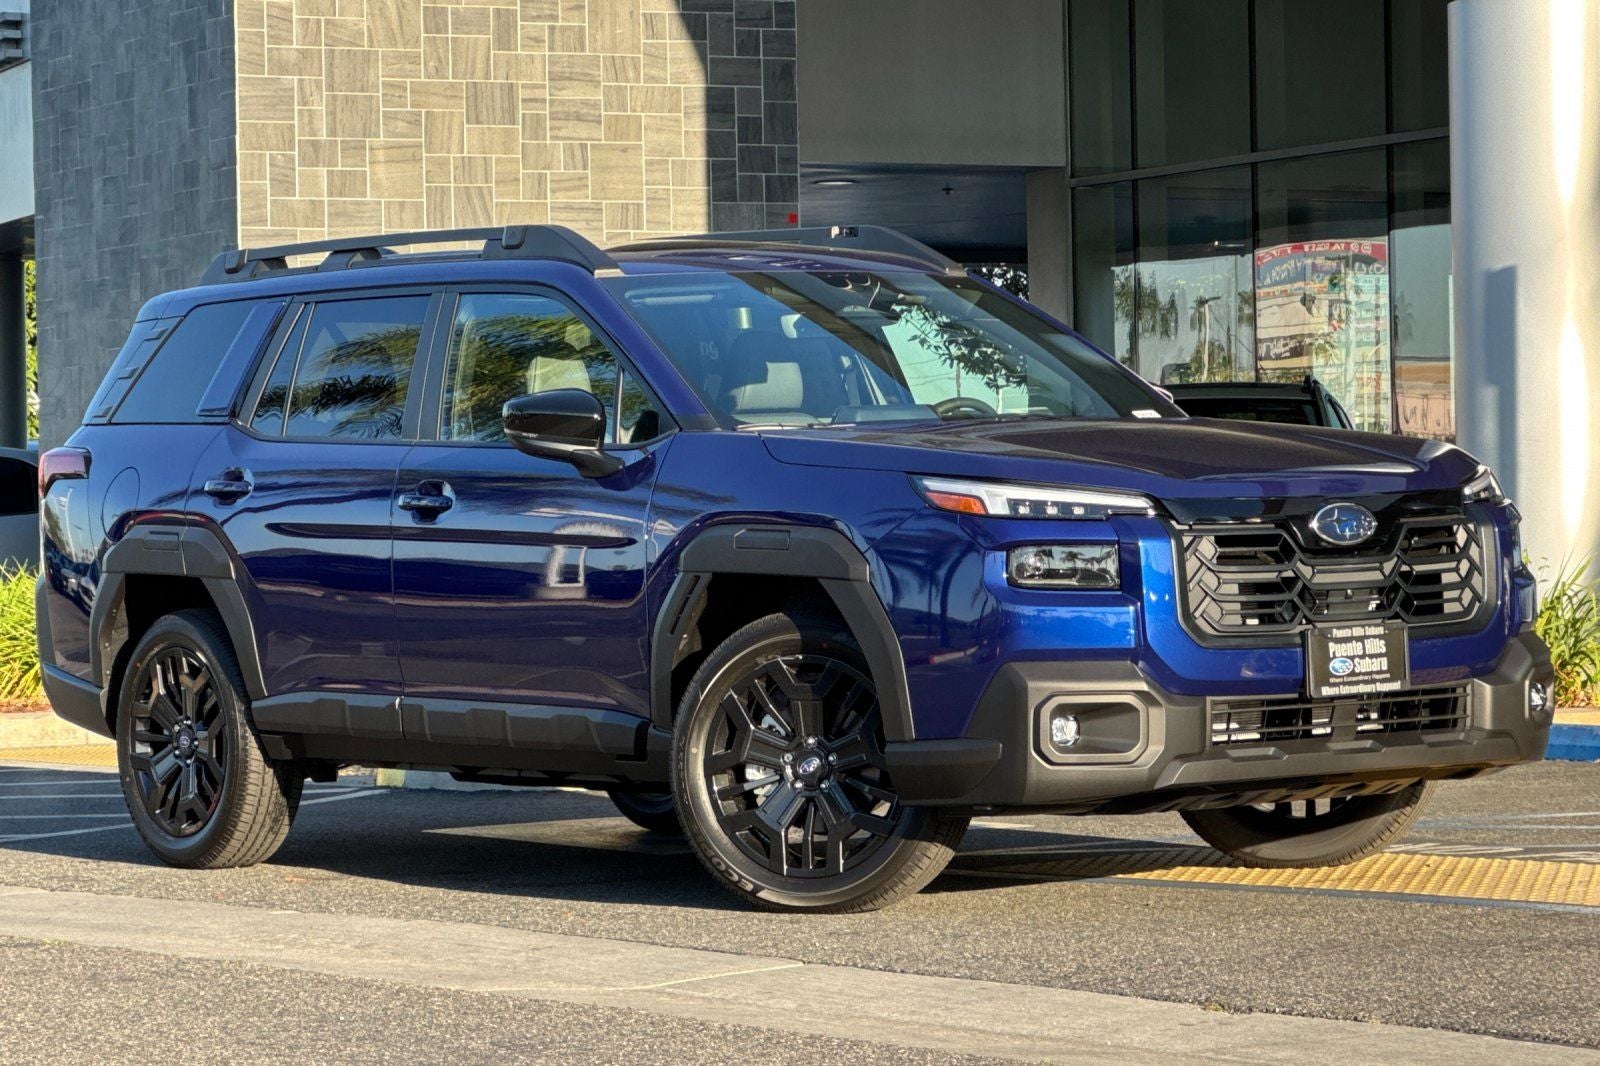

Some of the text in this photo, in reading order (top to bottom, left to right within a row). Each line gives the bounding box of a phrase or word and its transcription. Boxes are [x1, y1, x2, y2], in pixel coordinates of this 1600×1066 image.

[1332, 626, 1384, 638] Puente Hills Subaru
[1328, 638, 1386, 657] Puente Hills
[1354, 656, 1388, 673] Subaru
[1321, 686, 1339, 695] Where
[1340, 684, 1375, 694] Extraordinary
